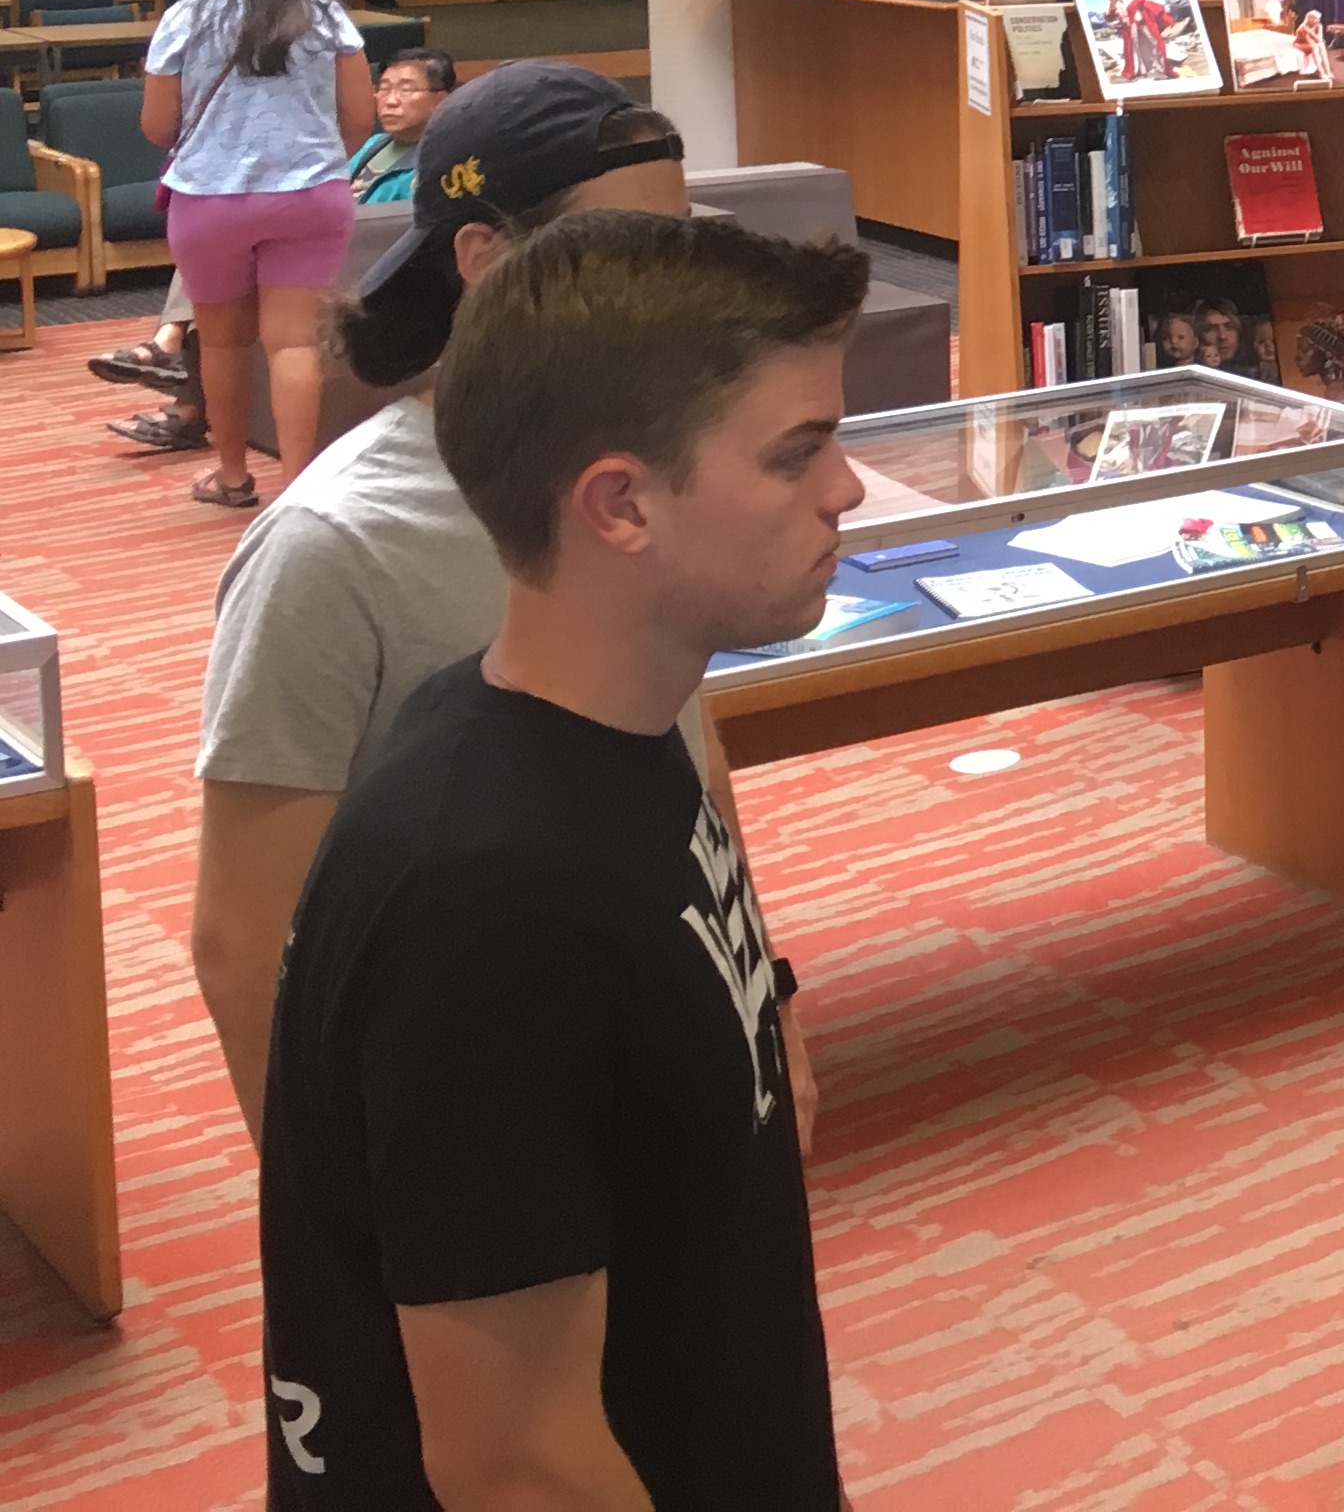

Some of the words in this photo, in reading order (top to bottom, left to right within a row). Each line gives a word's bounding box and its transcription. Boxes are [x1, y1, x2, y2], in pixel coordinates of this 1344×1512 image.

[1241, 147, 1300, 160] Against
[1238, 162, 1269, 174] Our
[1269, 159, 1303, 173] Will
